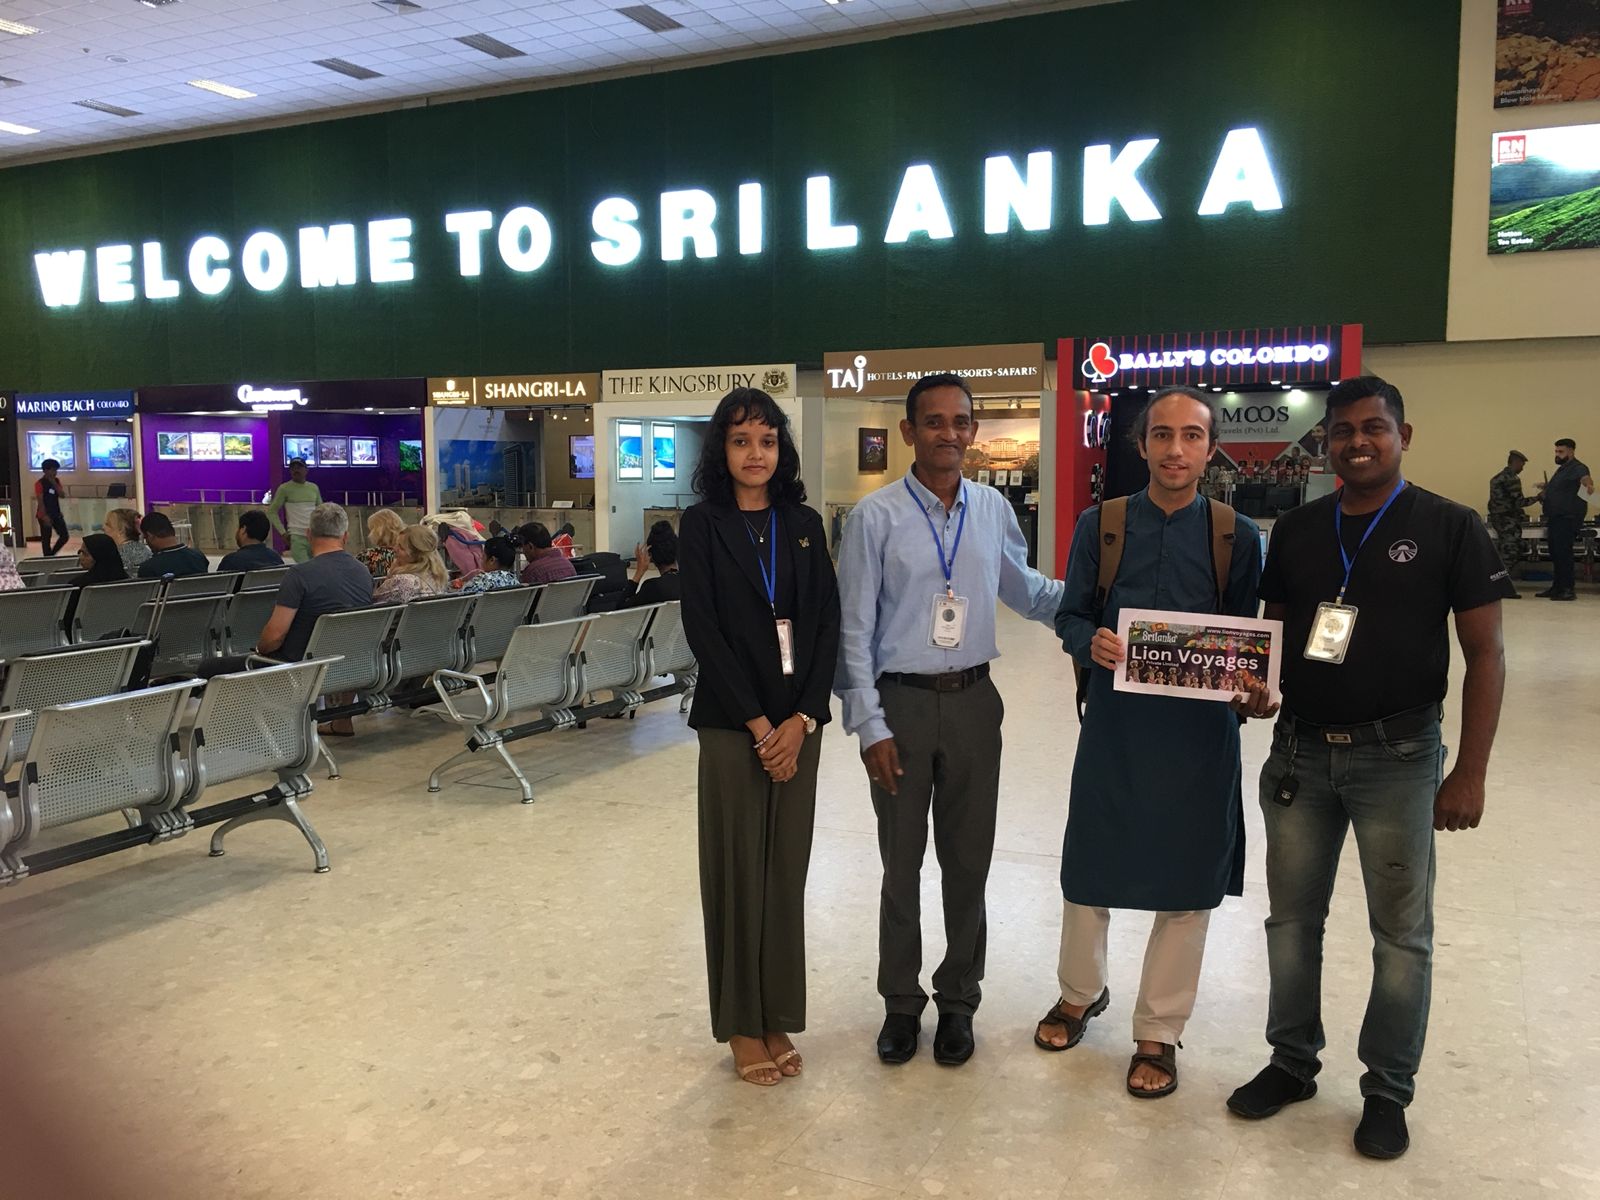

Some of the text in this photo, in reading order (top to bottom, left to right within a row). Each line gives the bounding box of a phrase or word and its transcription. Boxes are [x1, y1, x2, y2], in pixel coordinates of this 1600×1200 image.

[34, 127, 1284, 308] WELCOME TO SRI LANKA
[1119, 344, 1329, 370] BALLY'S COLOMBO
[608, 373, 756, 395] THE KINGSBURY
[867, 372, 903, 382] HOTELS
[950, 368, 993, 378] RESORTS
[997, 366, 1038, 377] SAFARIS
[485, 380, 586, 399] SHANGRI-LA
[16, 399, 130, 413] MARINO BEACH COLOMBO
[1131, 645, 1259, 672] Lion Voyages
